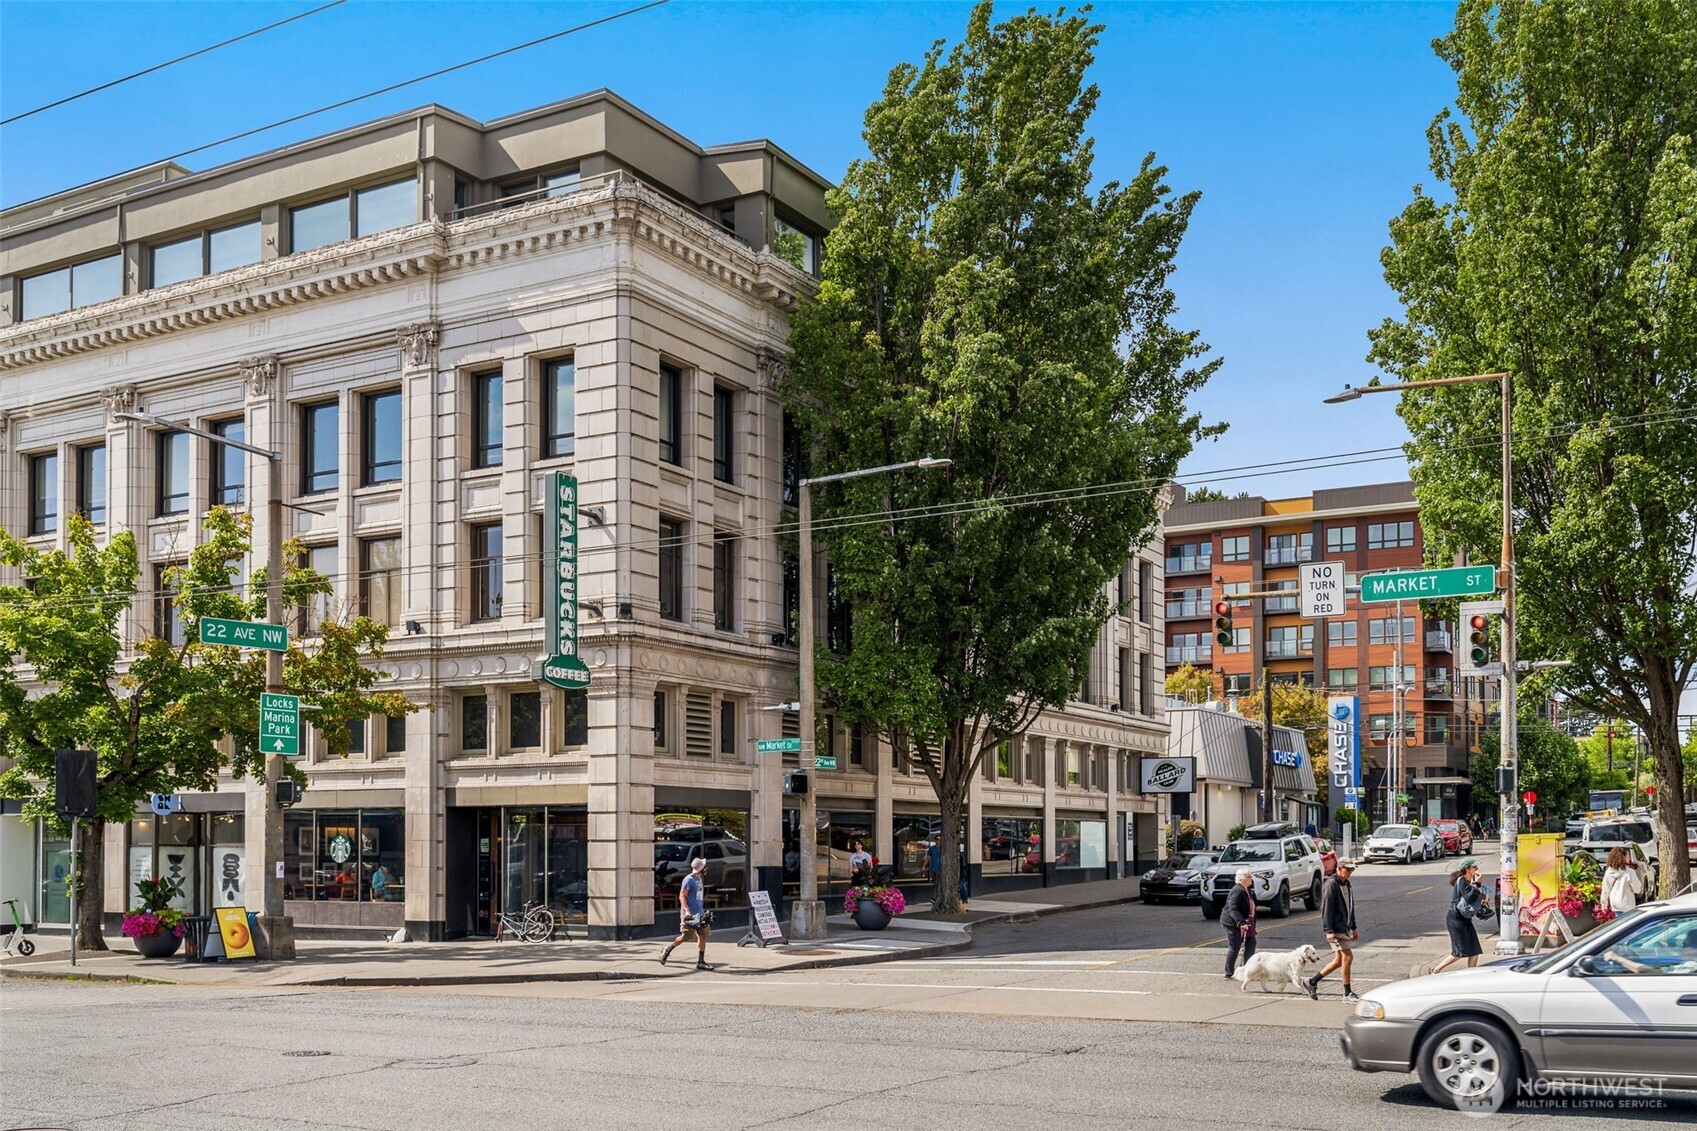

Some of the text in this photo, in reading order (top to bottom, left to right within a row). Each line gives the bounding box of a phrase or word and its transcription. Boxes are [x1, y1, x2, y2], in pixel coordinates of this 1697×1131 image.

[559, 485, 576, 655] STARBUCKS
[1312, 566, 1332, 579] NO
[1309, 580, 1336, 590] TURN
[1373, 574, 1481, 595] MARKET ST
[1316, 592, 1330, 602] ON
[1313, 604, 1333, 613] RED
[206, 623, 283, 644] 22 AVE NW
[545, 665, 589, 682] COFFEE
[266, 696, 294, 709] Locks
[264, 711, 295, 724] Marina
[268, 723, 291, 735] Park
[766, 740, 785, 750] Market
[1272, 750, 1296, 766] CHASE
[1334, 721, 1348, 787] CHASE
[1147, 767, 1186, 785] BALLARD
